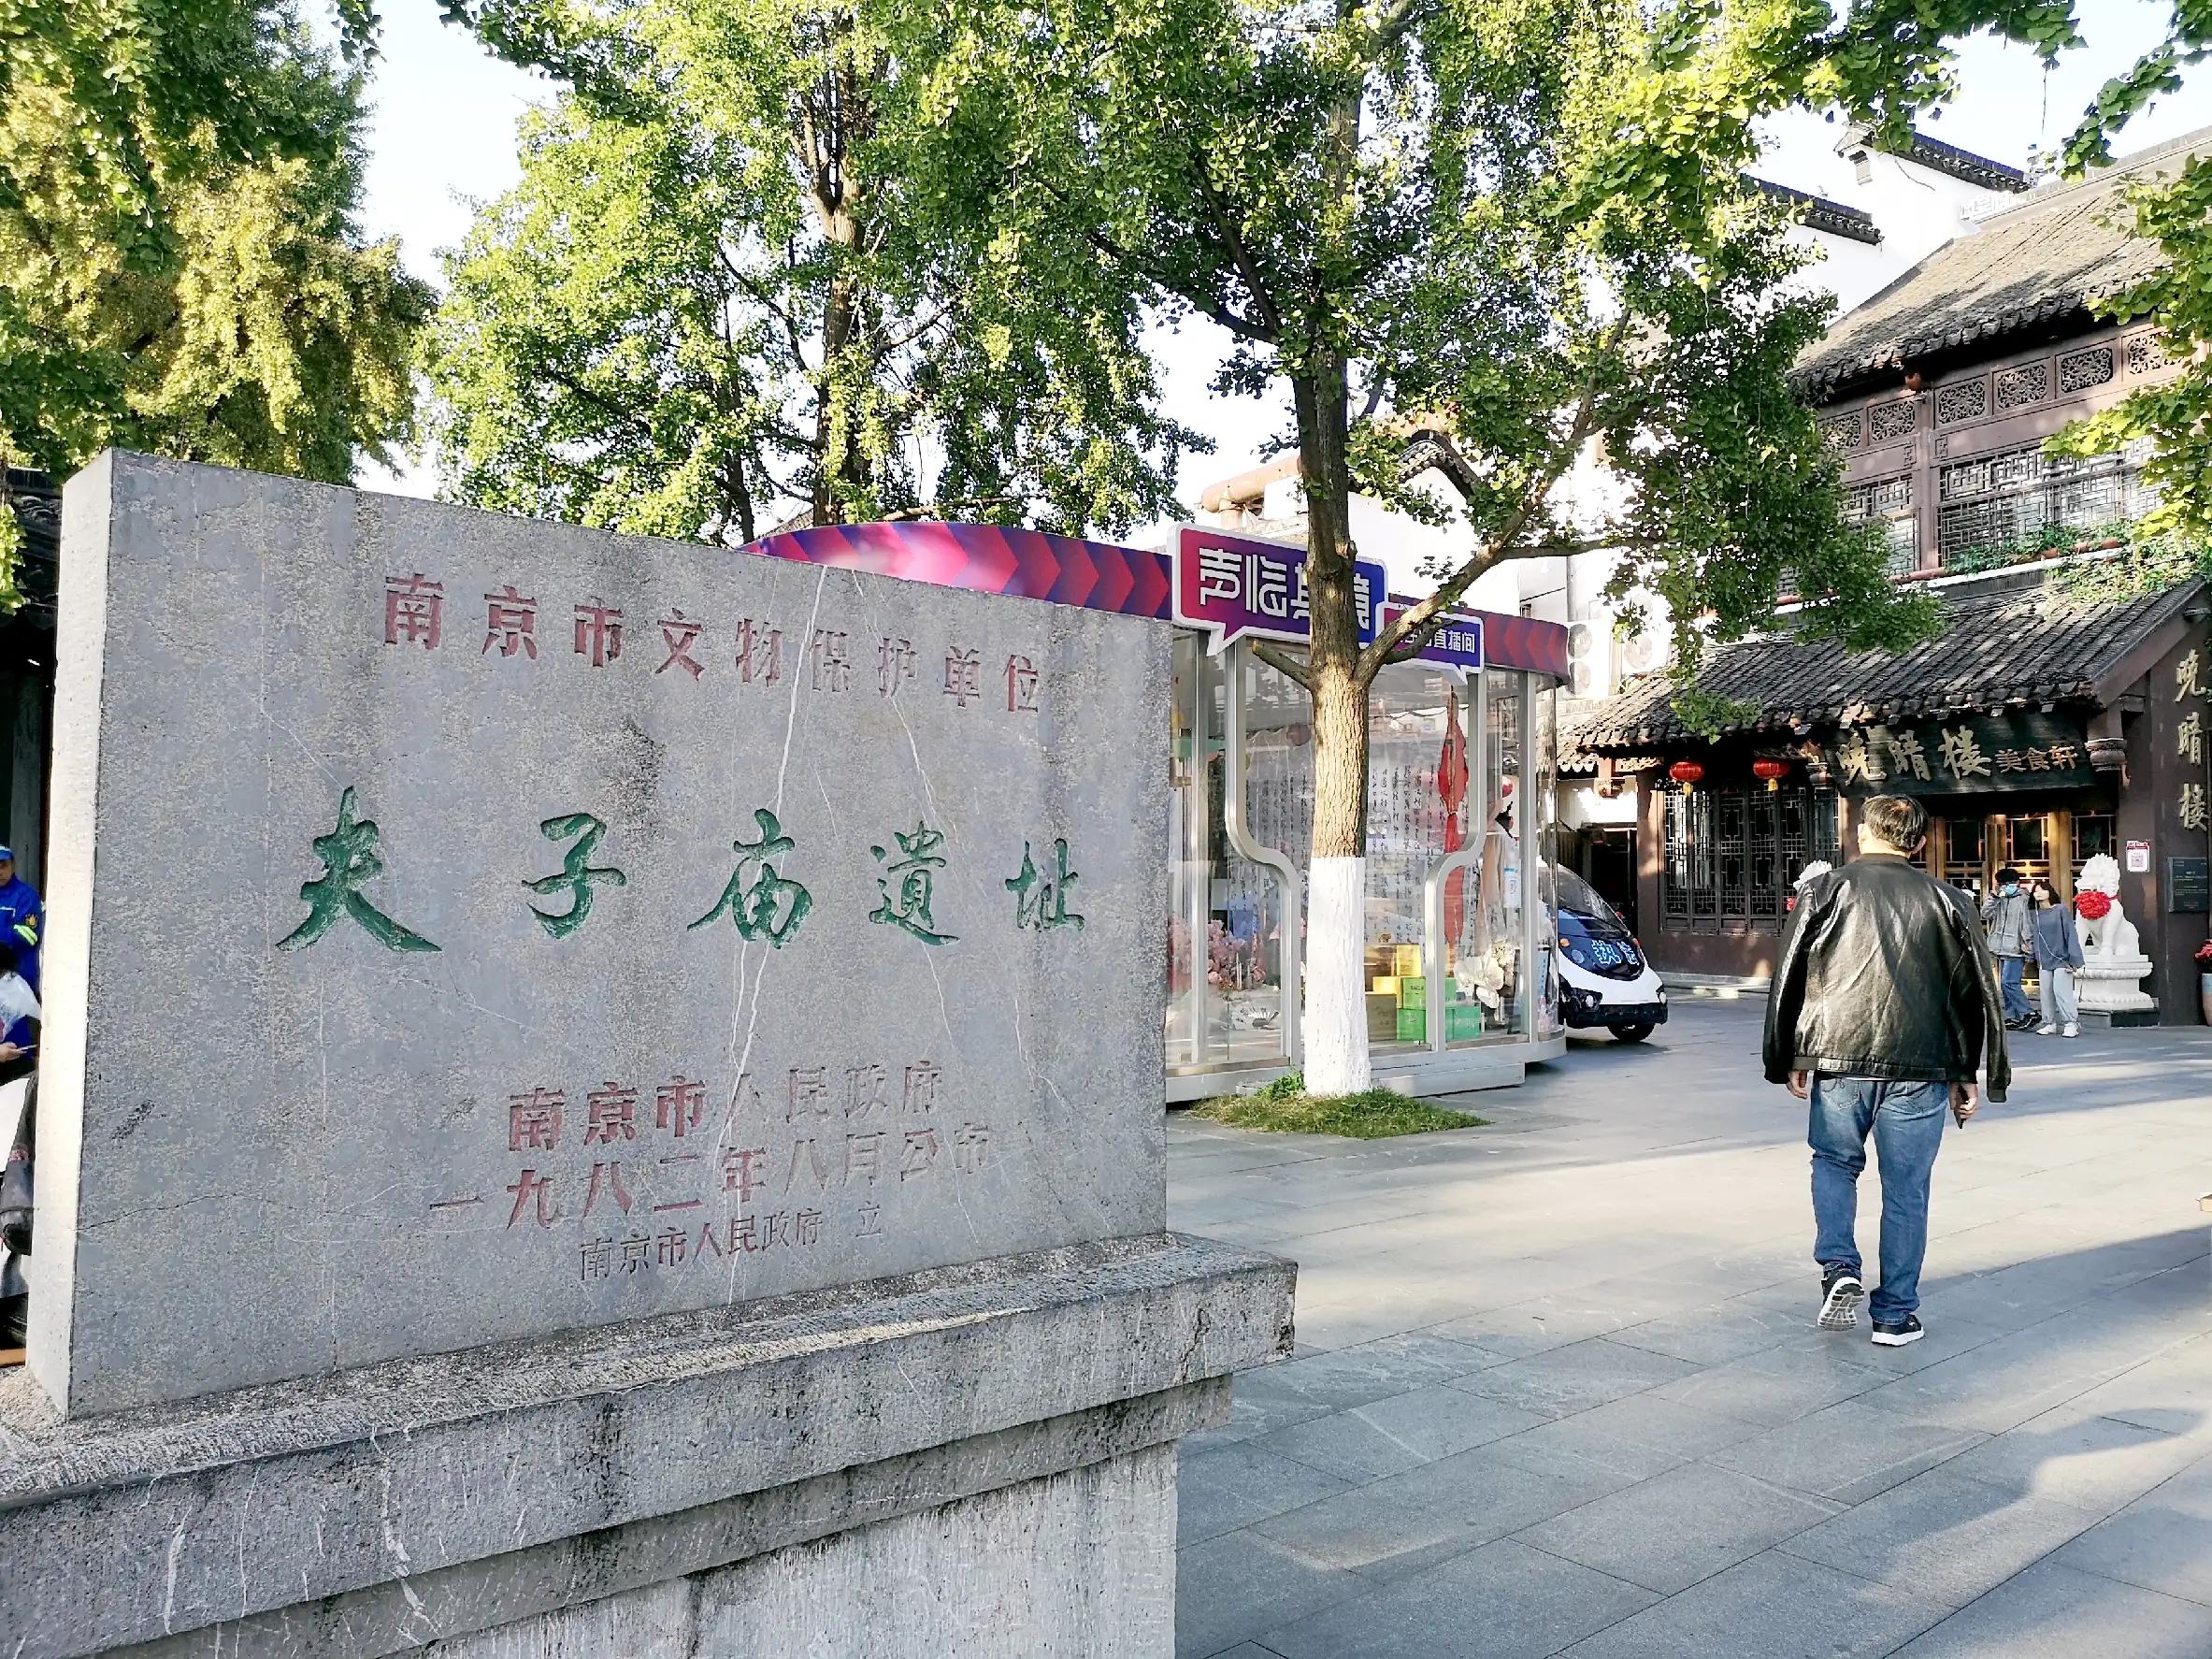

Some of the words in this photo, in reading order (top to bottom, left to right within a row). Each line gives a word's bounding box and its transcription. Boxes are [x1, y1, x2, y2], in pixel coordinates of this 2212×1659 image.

[383, 572, 1041, 713] 南京市文物保护单位
[509, 1060, 943, 1151] 南京市人民政府
